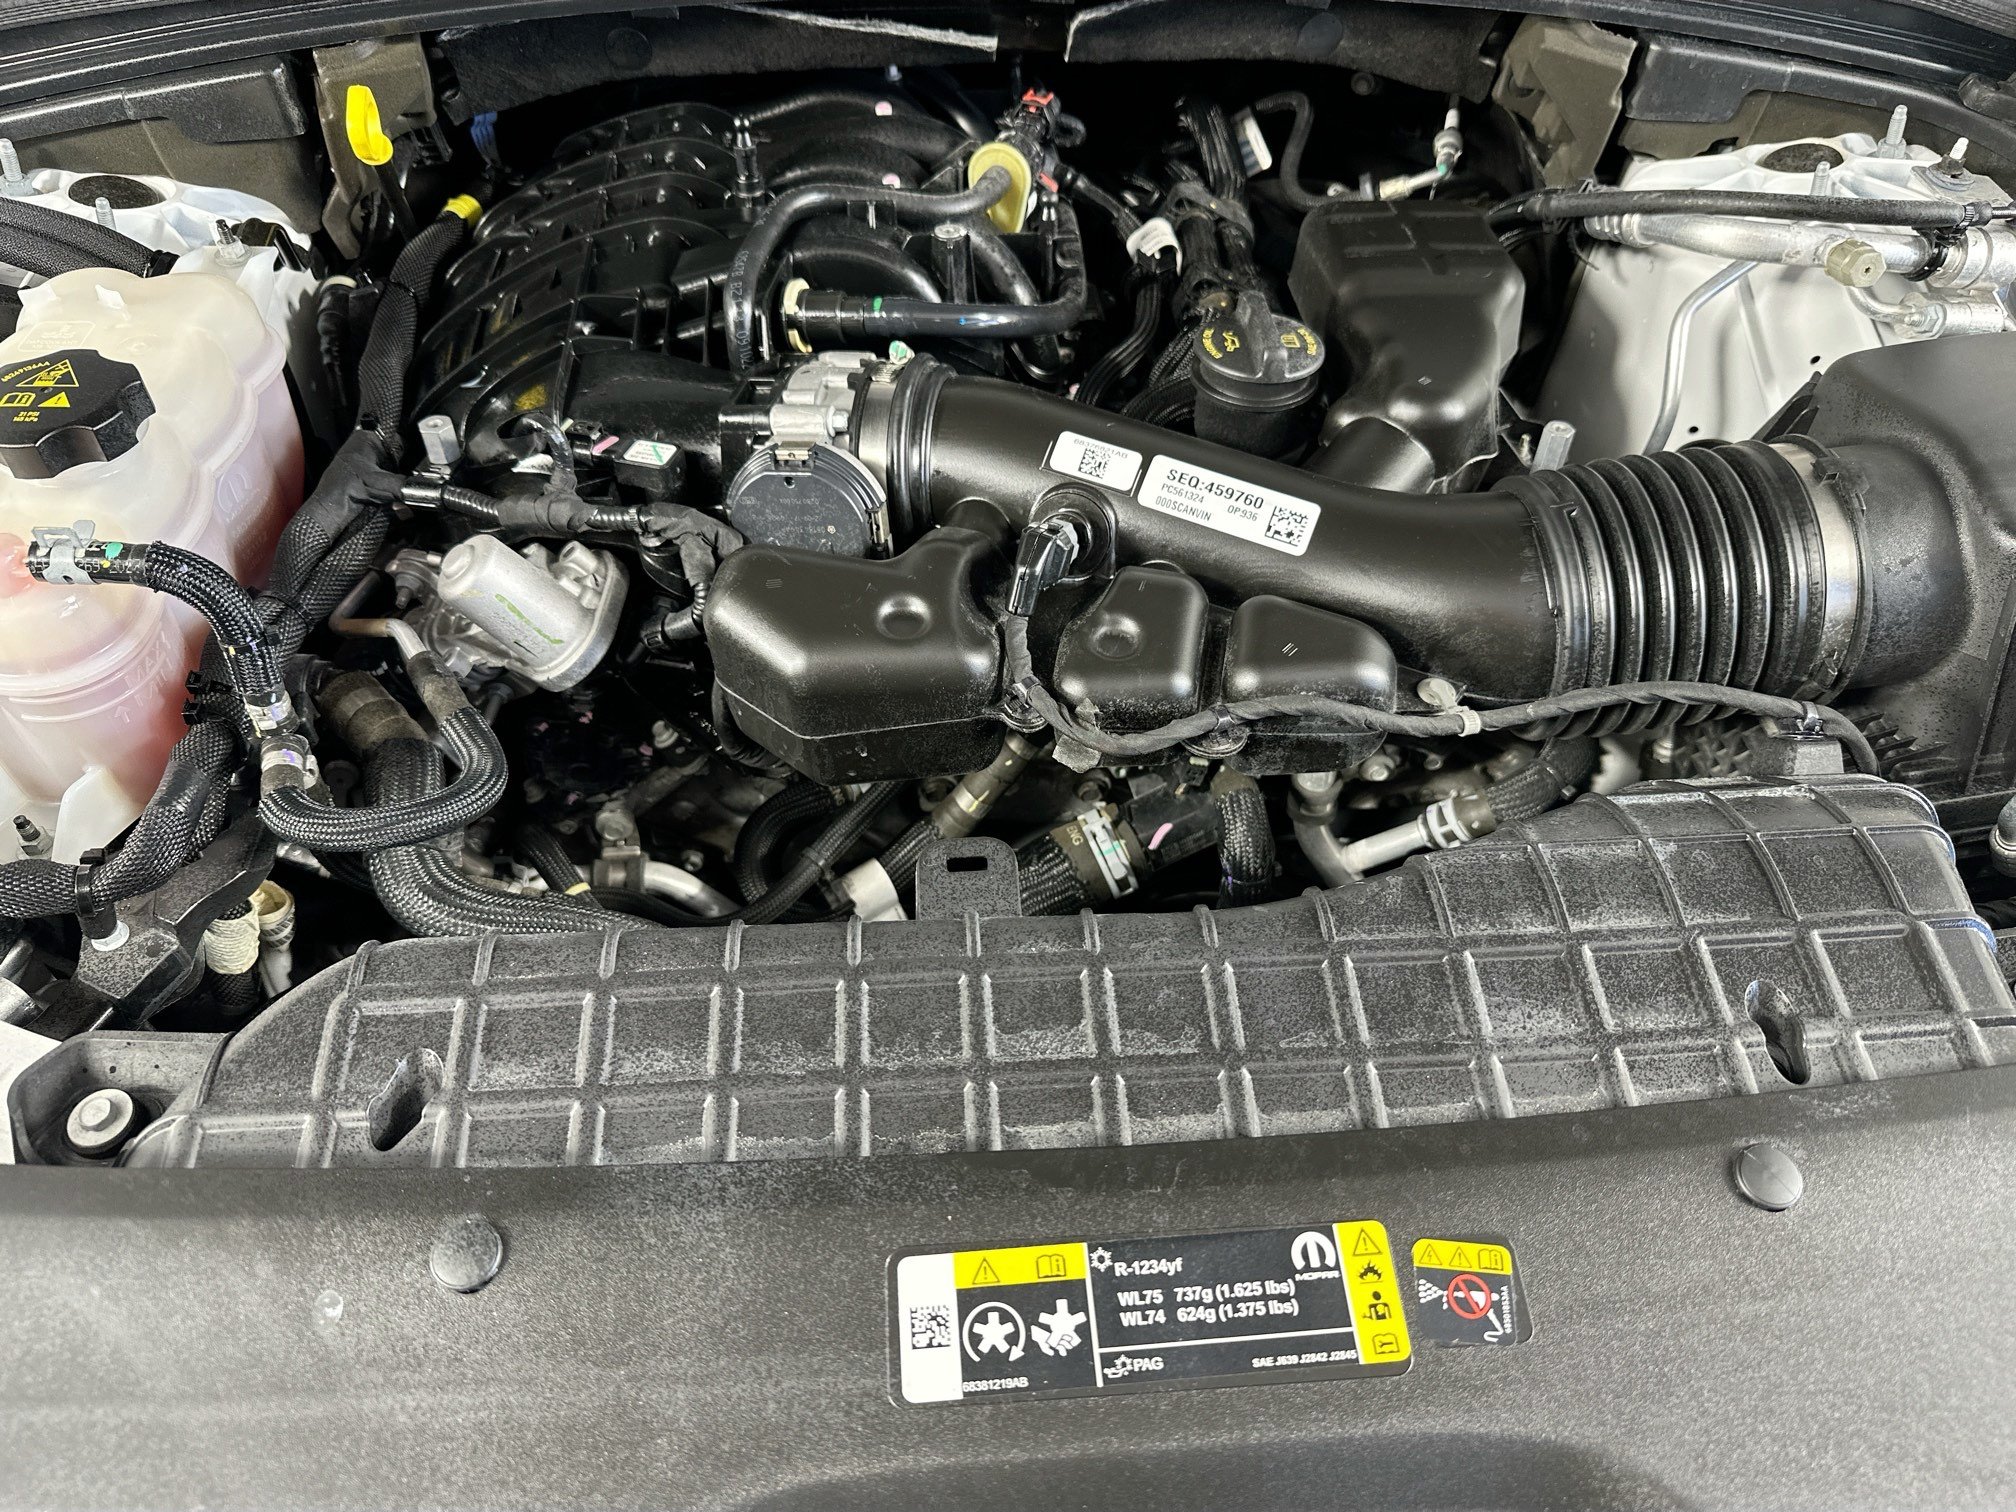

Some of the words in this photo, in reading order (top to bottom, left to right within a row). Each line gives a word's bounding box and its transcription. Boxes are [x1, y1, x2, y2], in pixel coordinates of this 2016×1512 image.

[1161, 482, 1205, 504] PC561324
[1166, 468, 1265, 510] SEQ:459760
[1155, 495, 1212, 522] 000SCANVIN
[1066, 825, 1083, 846] ENG
[1113, 1257, 1183, 1277] R-1234yf
[1294, 1270, 1340, 1281] MOPAR
[1117, 1289, 1164, 1307] WL75
[1173, 1286, 1214, 1303] 737g
[1215, 1281, 1263, 1302] (1.625
[1264, 1278, 1296, 1297] lbs)
[1119, 1309, 1167, 1327] WL74
[1176, 1305, 1217, 1323] 624g
[1218, 1301, 1267, 1322] (1.375
[1267, 1298, 1299, 1317] lbs)
[1132, 1356, 1165, 1372] PAG
[1251, 1357, 1275, 1368] SAE
[1275, 1354, 1300, 1366] J639
[1299, 1351, 1328, 1363] J2842
[1328, 1349, 1357, 1361] J2845
[962, 1376, 1029, 1393] 68381219AB
